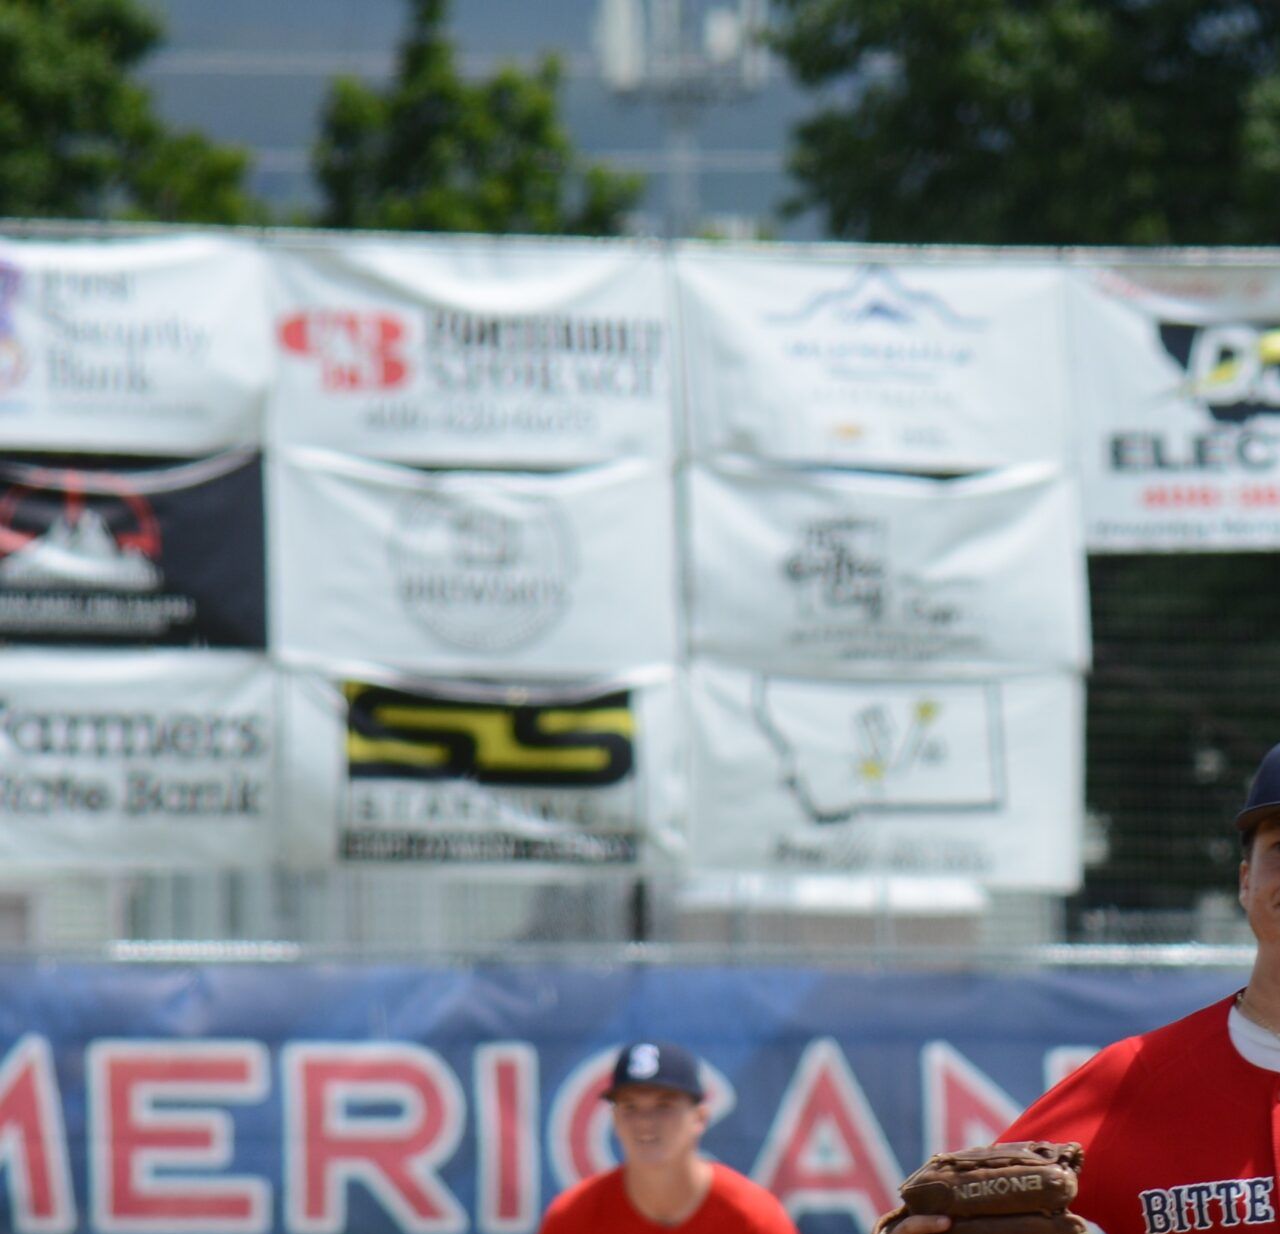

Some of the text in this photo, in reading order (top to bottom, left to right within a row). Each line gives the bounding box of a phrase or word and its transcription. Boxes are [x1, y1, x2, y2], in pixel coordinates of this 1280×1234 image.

[0, 700, 266, 756] armers
[123, 768, 264, 818] Bank
[953, 1174, 1042, 1200] NOKONA
